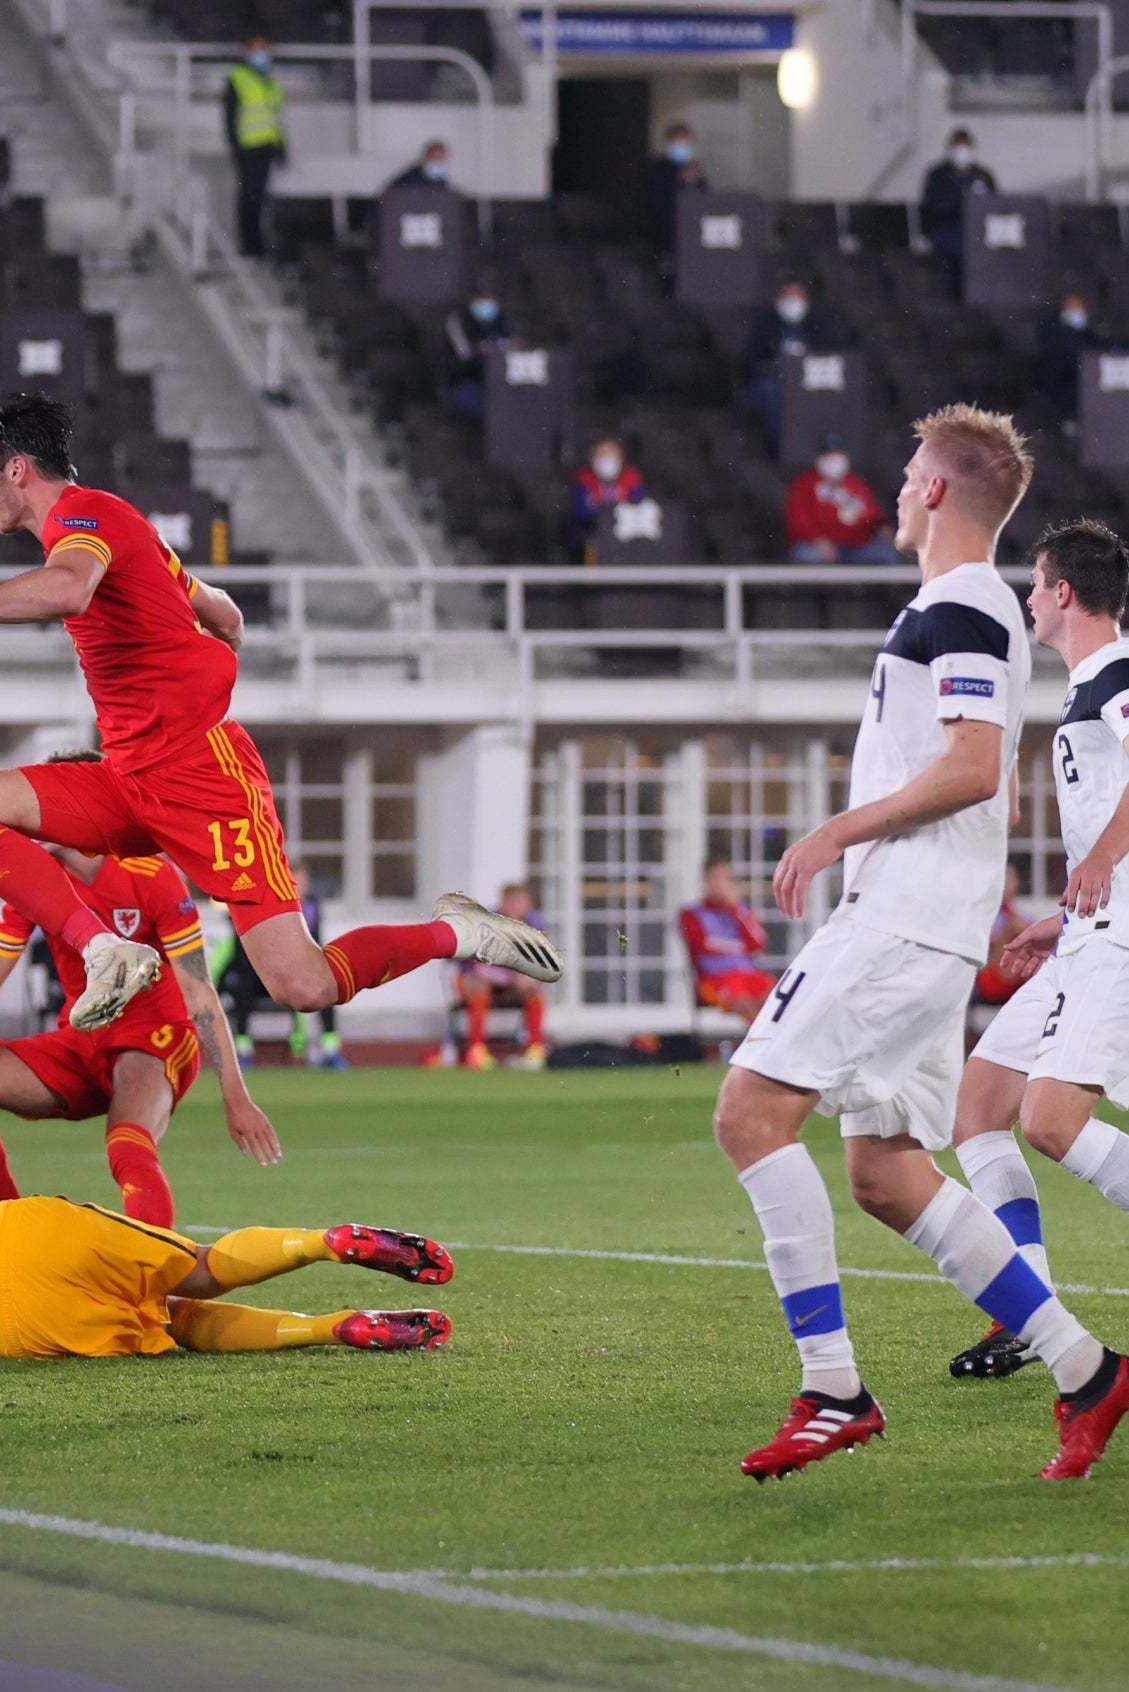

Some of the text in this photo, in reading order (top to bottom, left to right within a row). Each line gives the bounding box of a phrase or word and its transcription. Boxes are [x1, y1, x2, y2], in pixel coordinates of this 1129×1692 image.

[64, 519, 97, 529] RESPECT
[952, 681, 993, 694] RESPECT
[1058, 734, 1079, 785] 2
[208, 818, 255, 871] 13
[771, 968, 806, 1024] 4
[1041, 991, 1066, 1040] 2
